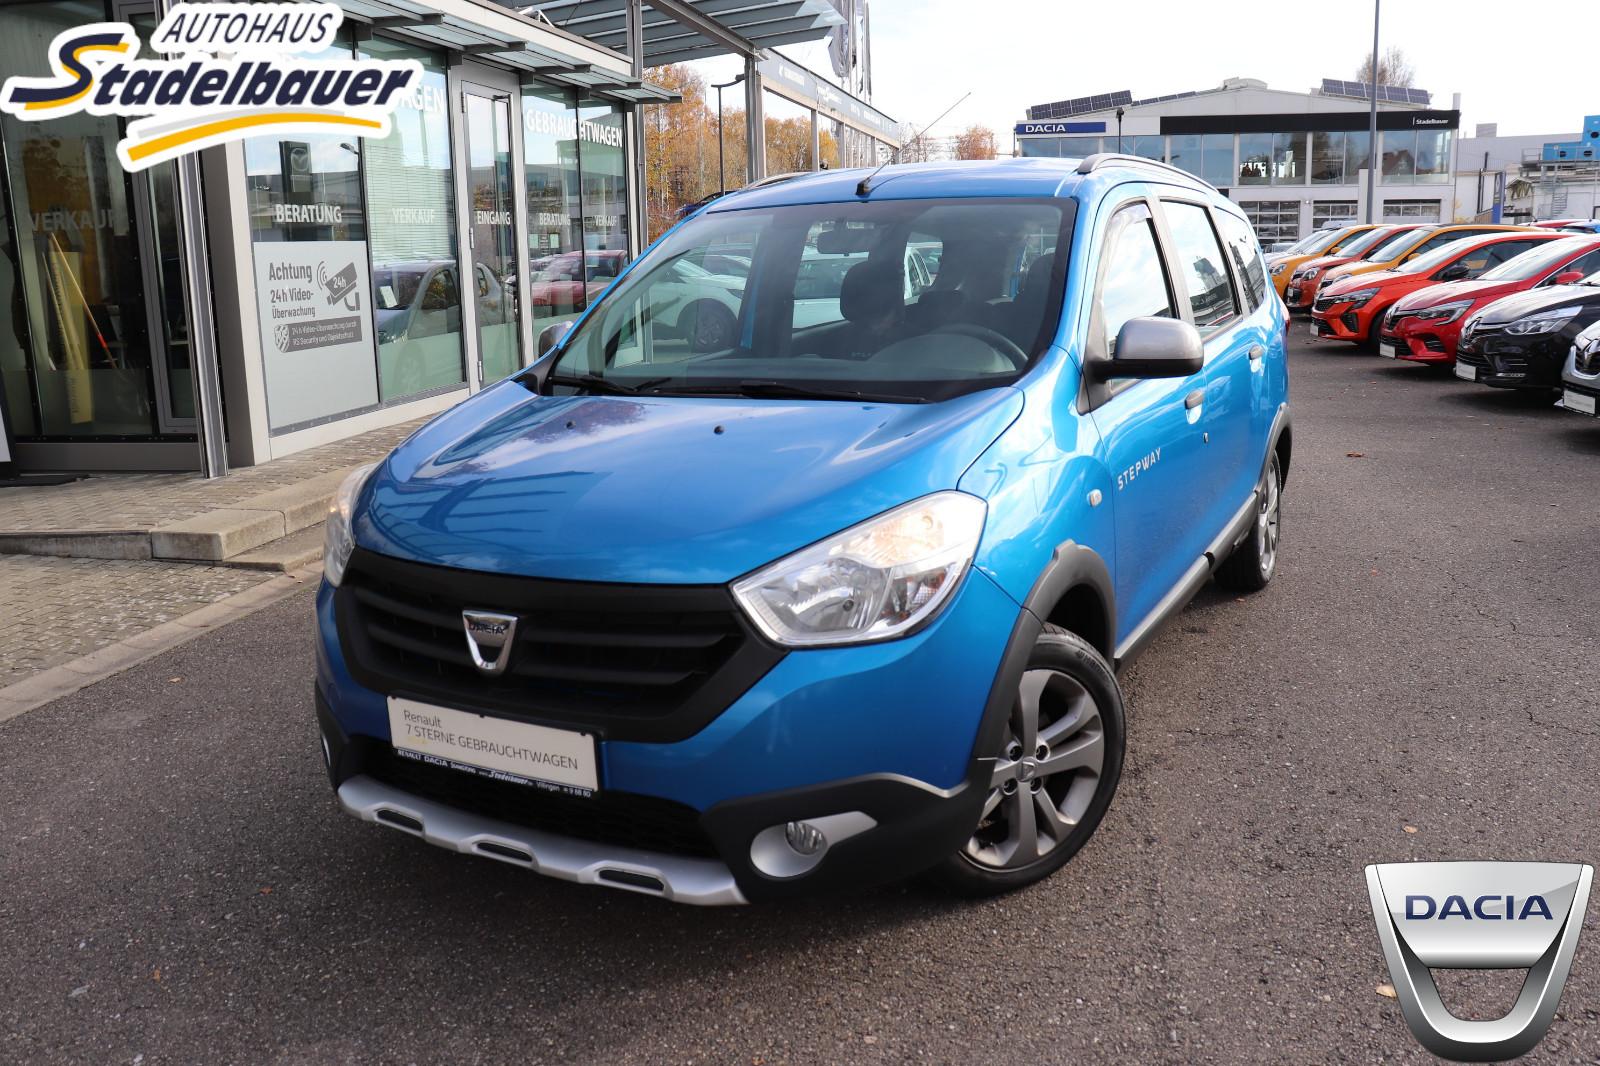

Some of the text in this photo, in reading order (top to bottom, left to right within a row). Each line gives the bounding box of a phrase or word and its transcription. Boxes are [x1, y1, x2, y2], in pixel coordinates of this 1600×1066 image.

[1025, 124, 1066, 133] DACIA
[275, 204, 342, 223] BERATUNG
[392, 208, 435, 224] VERKAUF
[477, 211, 510, 225] EINGANG
[539, 212, 571, 226] BERATUNG
[594, 214, 617, 227] VERKAUF
[269, 262, 313, 283] Achtung
[289, 287, 314, 301] Video-
[272, 305, 316, 319] Überwachung
[1117, 446, 1161, 491] STEPWAY
[404, 709, 442, 729] Renault
[406, 723, 412, 735] 7
[414, 726, 456, 746] STERNE
[458, 735, 578, 770] GEBRAUCHTWAGEN
[424, 755, 448, 767] DACIA
